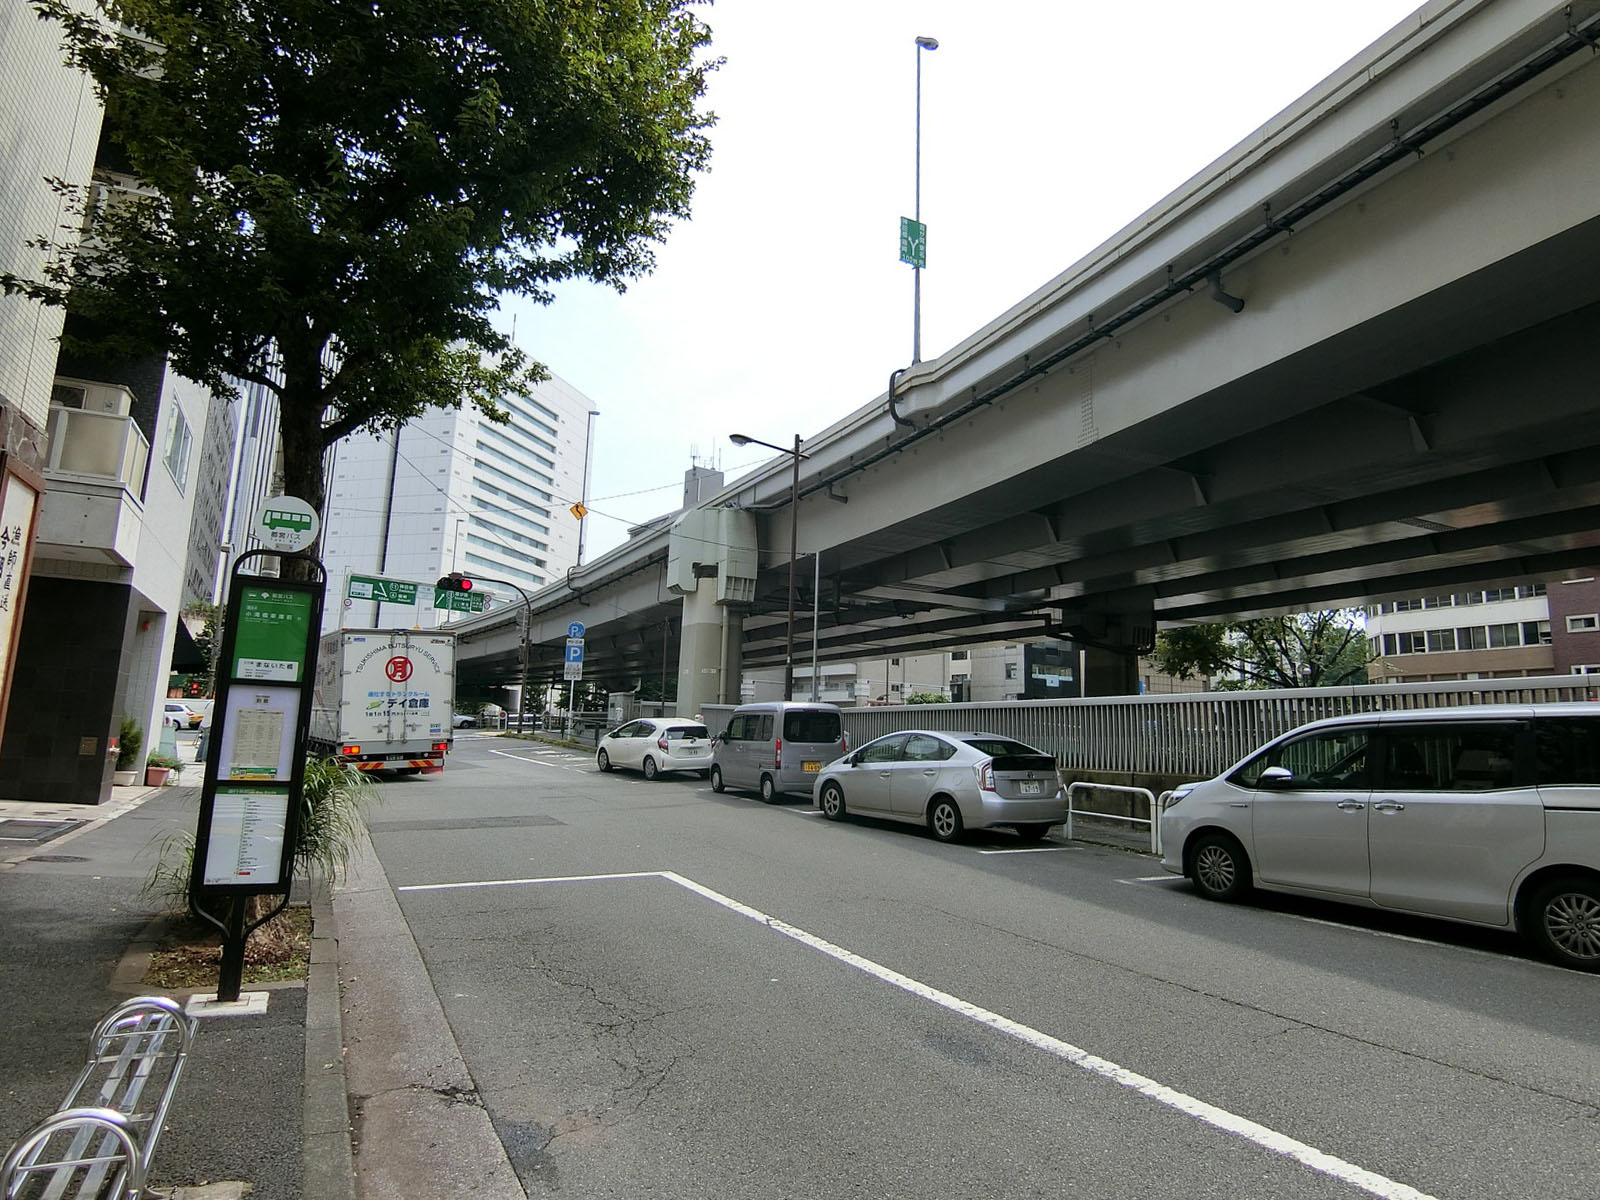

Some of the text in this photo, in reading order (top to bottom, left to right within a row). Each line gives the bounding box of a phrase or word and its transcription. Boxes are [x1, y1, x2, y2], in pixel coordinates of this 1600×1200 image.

[271, 531, 301, 540] 都営バス
[355, 644, 387, 674] TSUKISHIMA
[388, 642, 423, 654] BUTSURYU
[570, 647, 580, 661] P
